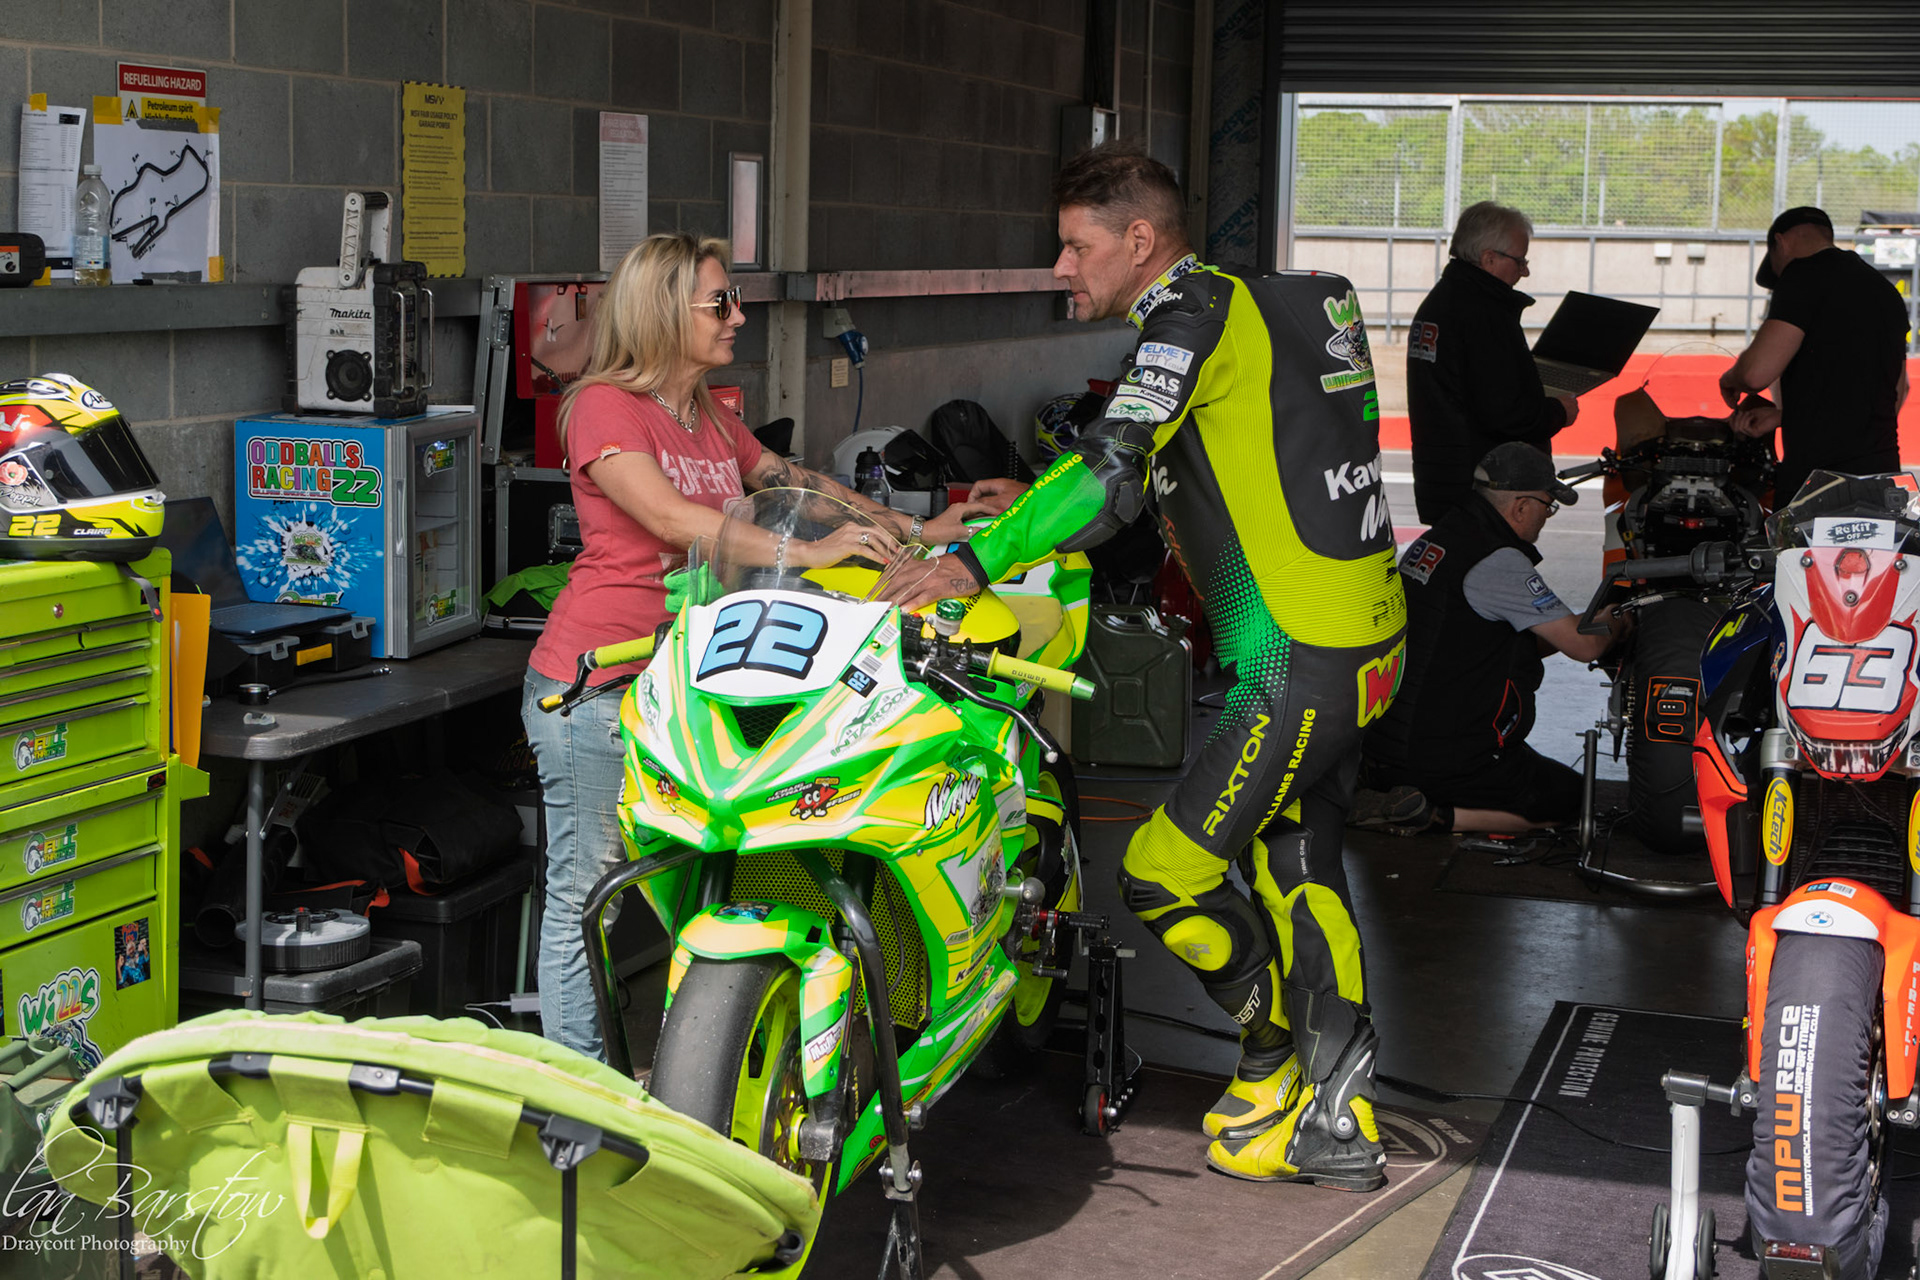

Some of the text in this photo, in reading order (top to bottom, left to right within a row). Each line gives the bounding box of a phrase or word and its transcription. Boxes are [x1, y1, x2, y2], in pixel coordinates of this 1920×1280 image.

[123, 72, 202, 91] REFUELLING HAZARD
[147, 100, 194, 115] Petroleum spirit
[1140, 343, 1192, 363] HELMET
[1145, 353, 1171, 367] CITY
[1141, 369, 1182, 392] BAS
[1139, 389, 1176, 408] Kawasaki
[251, 441, 361, 469] ODDBALLS
[252, 465, 379, 504] RACING 22
[1034, 453, 1084, 490] RACING
[8, 514, 61, 537] 22
[73, 527, 113, 536] CLAIRE
[696, 598, 829, 683] 22
[1787, 622, 1914, 714] 63
[1202, 712, 1271, 837] RIXTON
[1252, 708, 1317, 837] WILLIAMS RACING
[1557, 1011, 1621, 1098] GENUINE PROTECTION
[1275, 1060, 1300, 1108] RST
